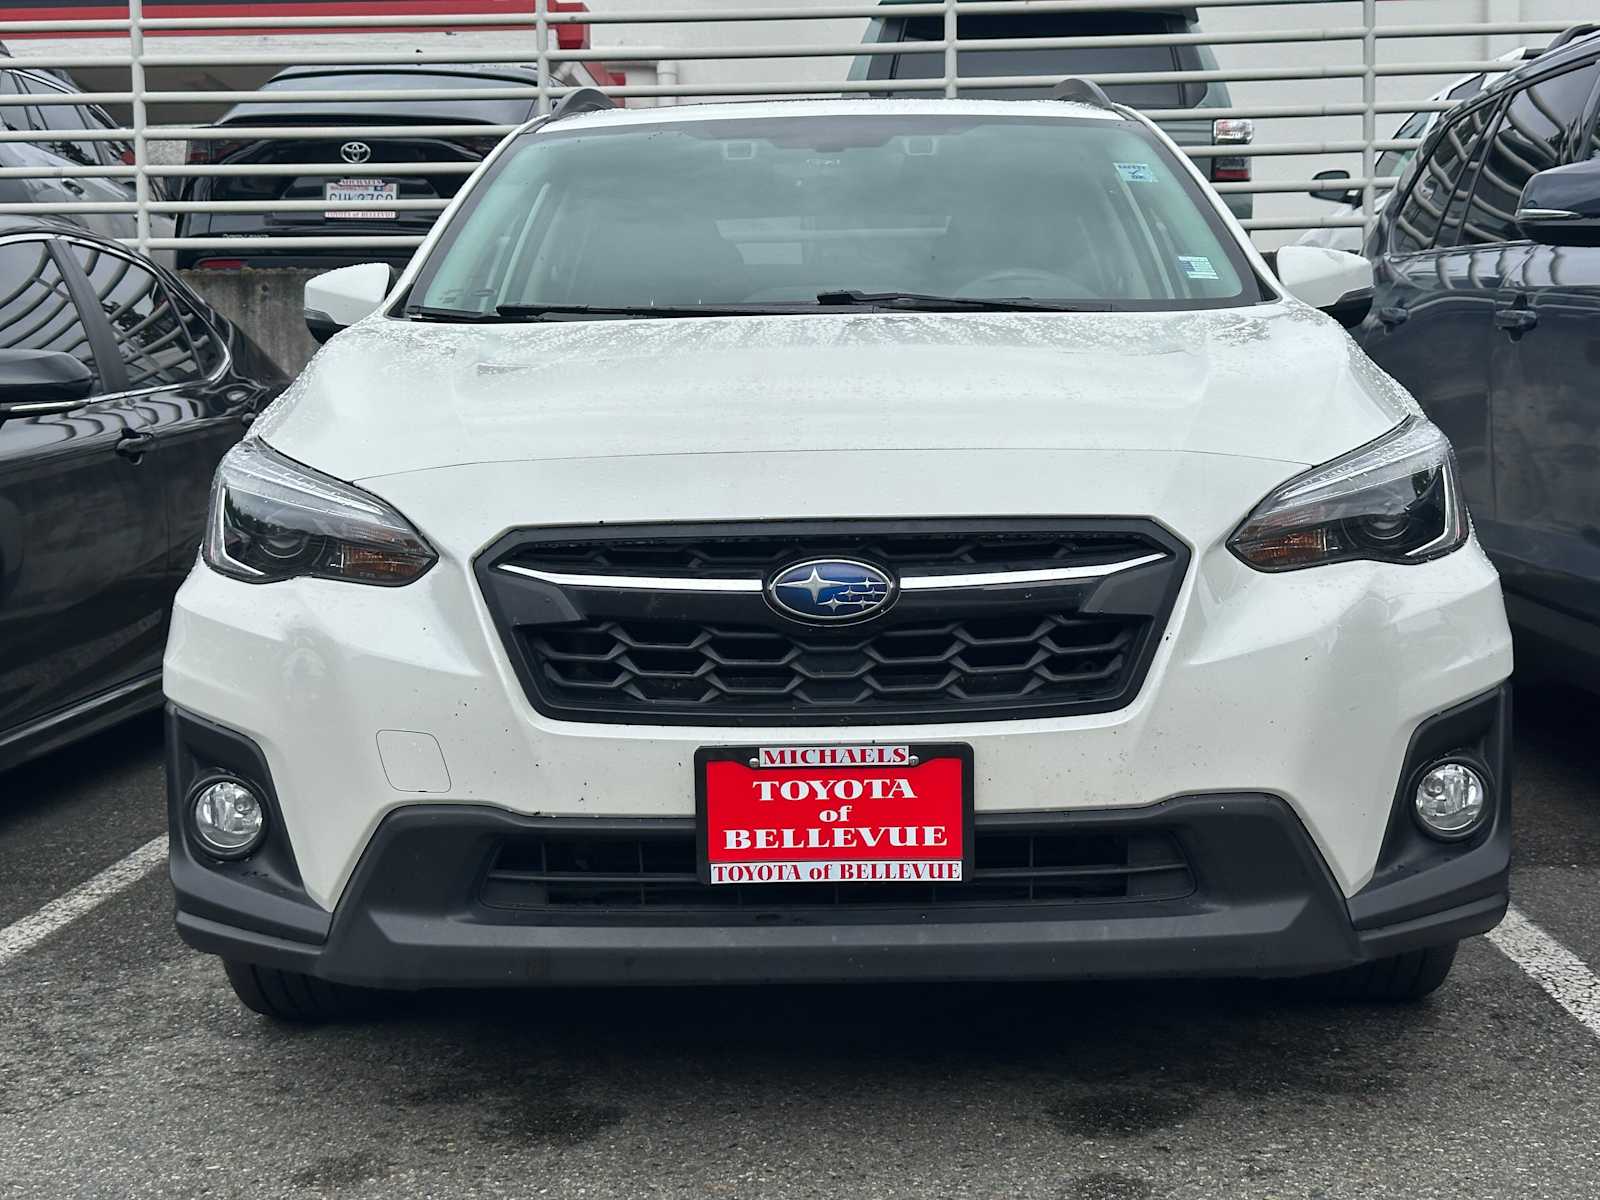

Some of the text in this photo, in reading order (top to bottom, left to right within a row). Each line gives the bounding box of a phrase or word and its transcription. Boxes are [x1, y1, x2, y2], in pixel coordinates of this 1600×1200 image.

[763, 747, 907, 765] MICHAELS
[752, 778, 918, 801] TOYOTA
[819, 805, 853, 822] of
[723, 826, 948, 850] BELLEVUE
[713, 862, 960, 882] TOYOTA of BELLEVUE
